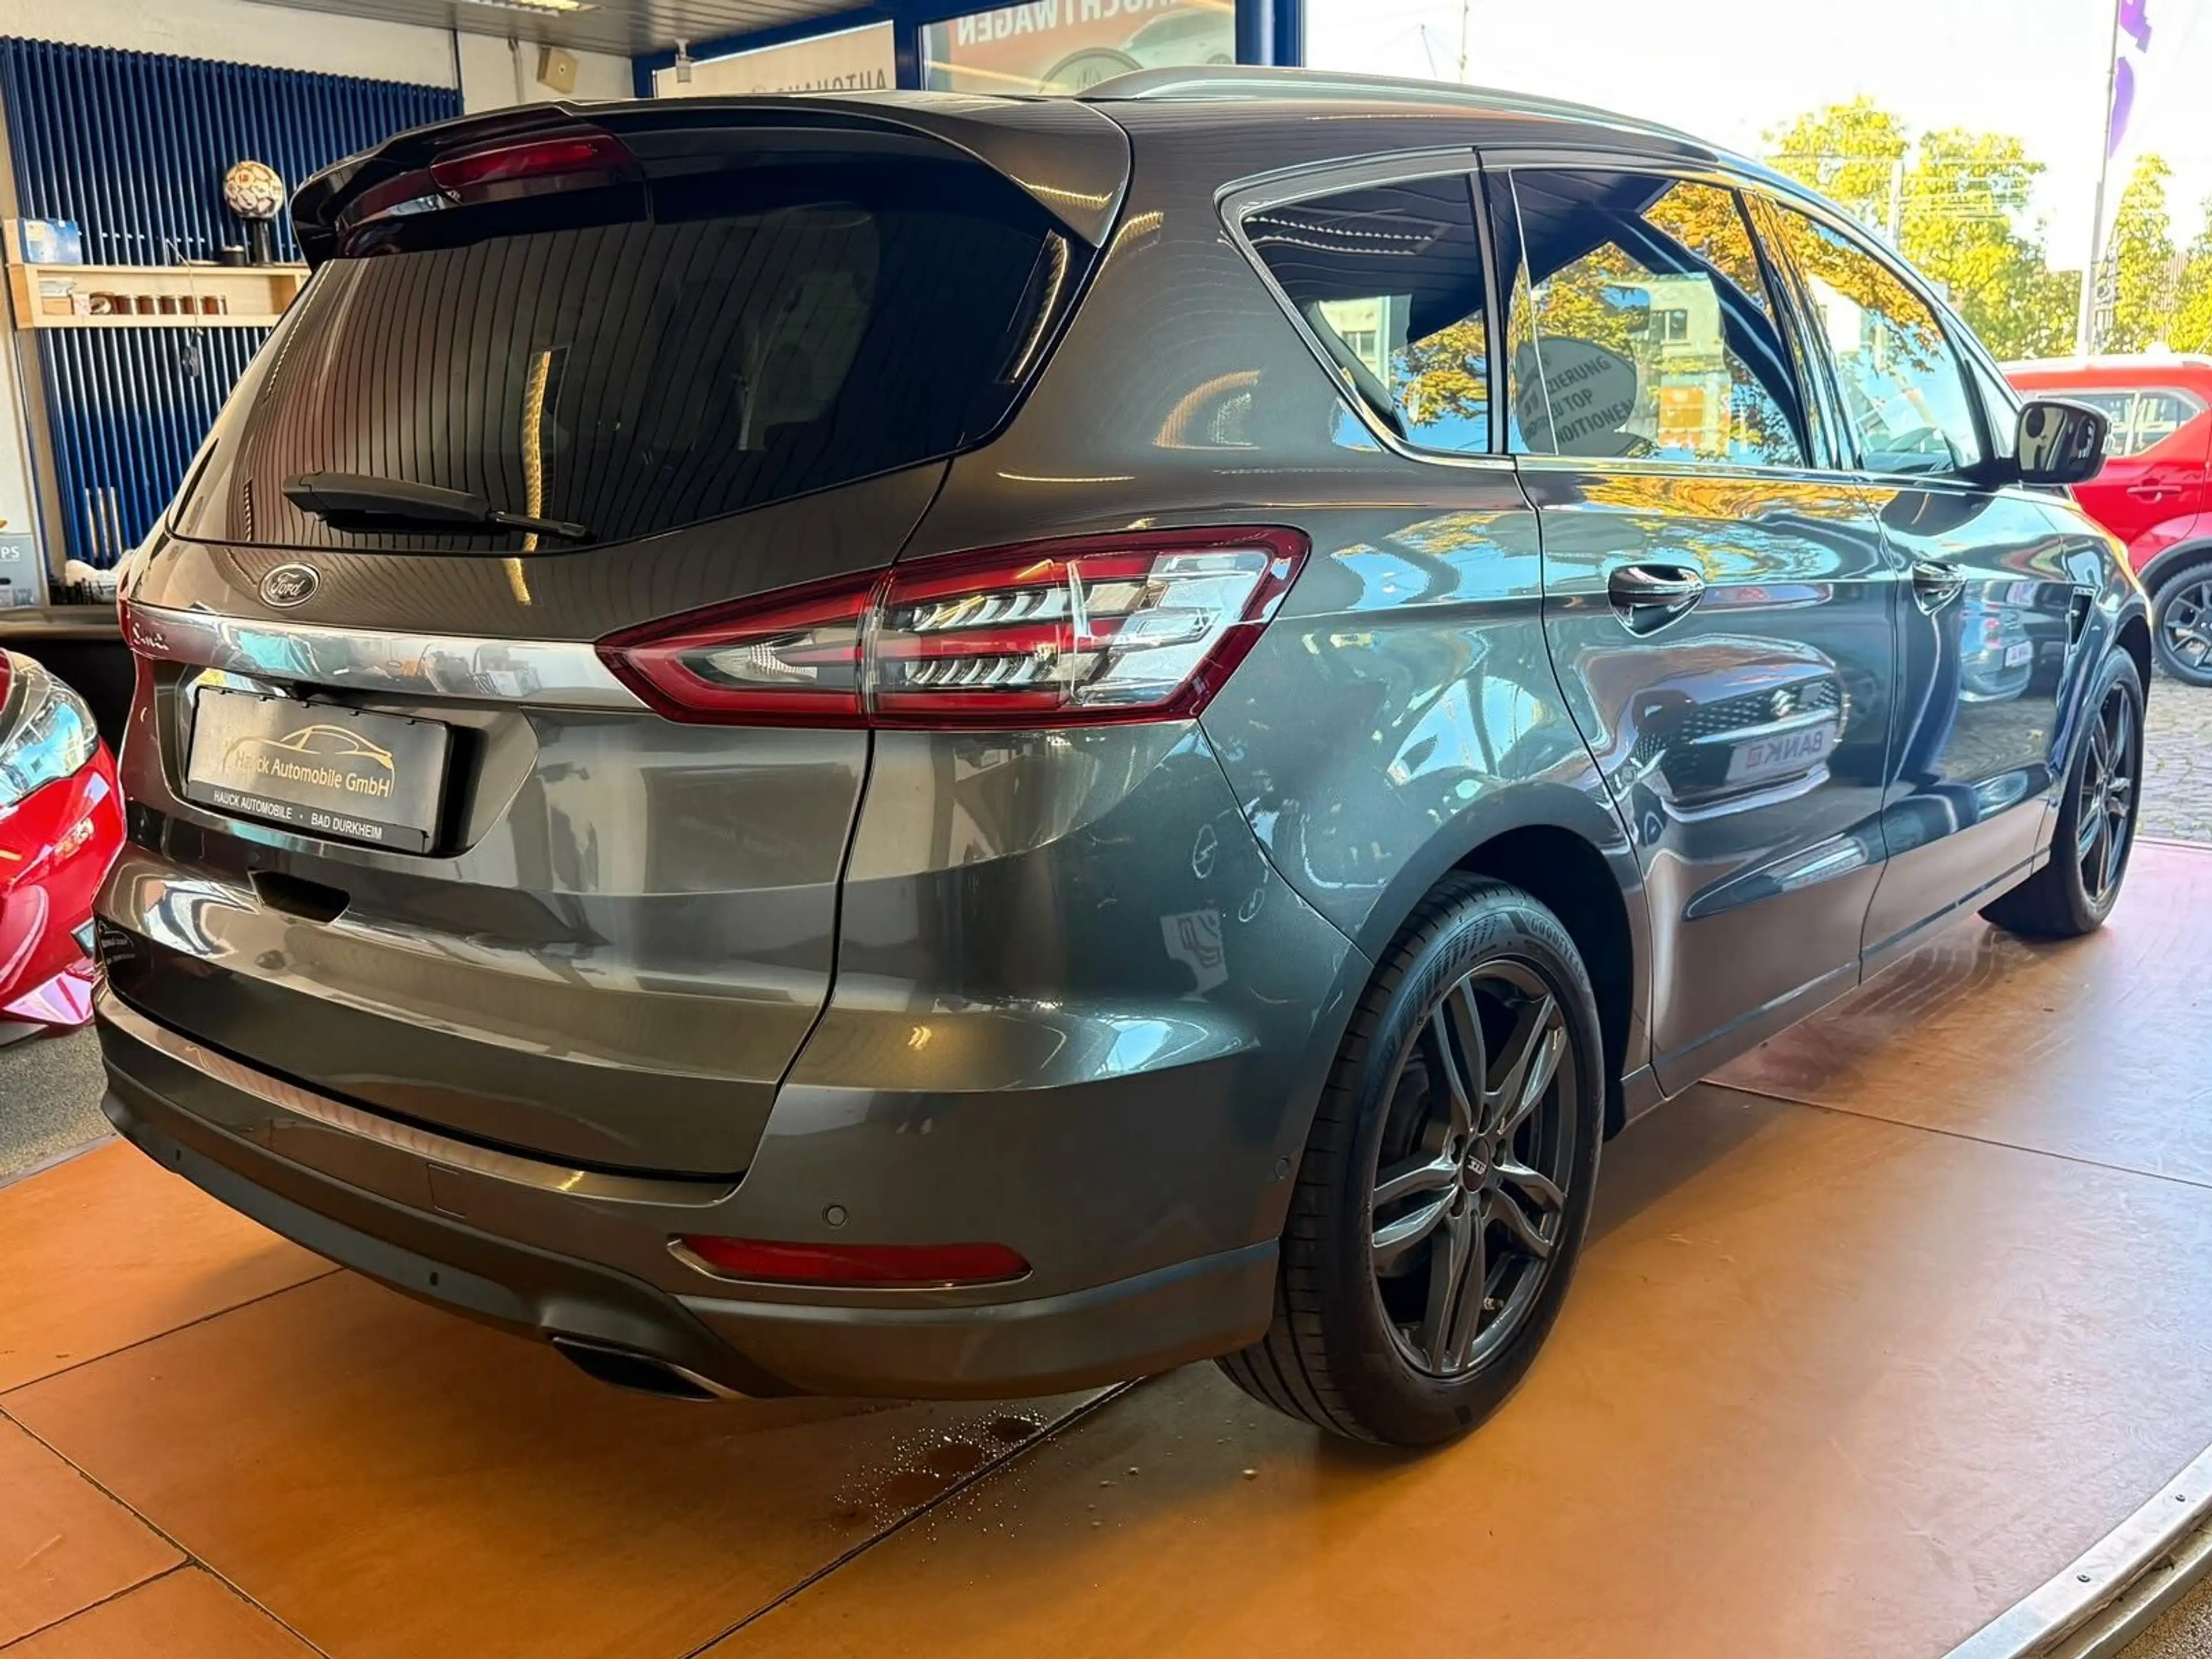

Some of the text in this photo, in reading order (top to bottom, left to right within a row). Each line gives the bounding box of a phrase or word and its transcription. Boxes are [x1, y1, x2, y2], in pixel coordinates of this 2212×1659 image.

[1562, 387, 1593, 412] TOP
[271, 572, 306, 596] Ford
[235, 750, 391, 797] Hauck Automobile GmbH
[214, 790, 240, 807] HAUCK
[240, 799, 293, 820] AUTOMOBILE
[310, 813, 331, 828] BAD
